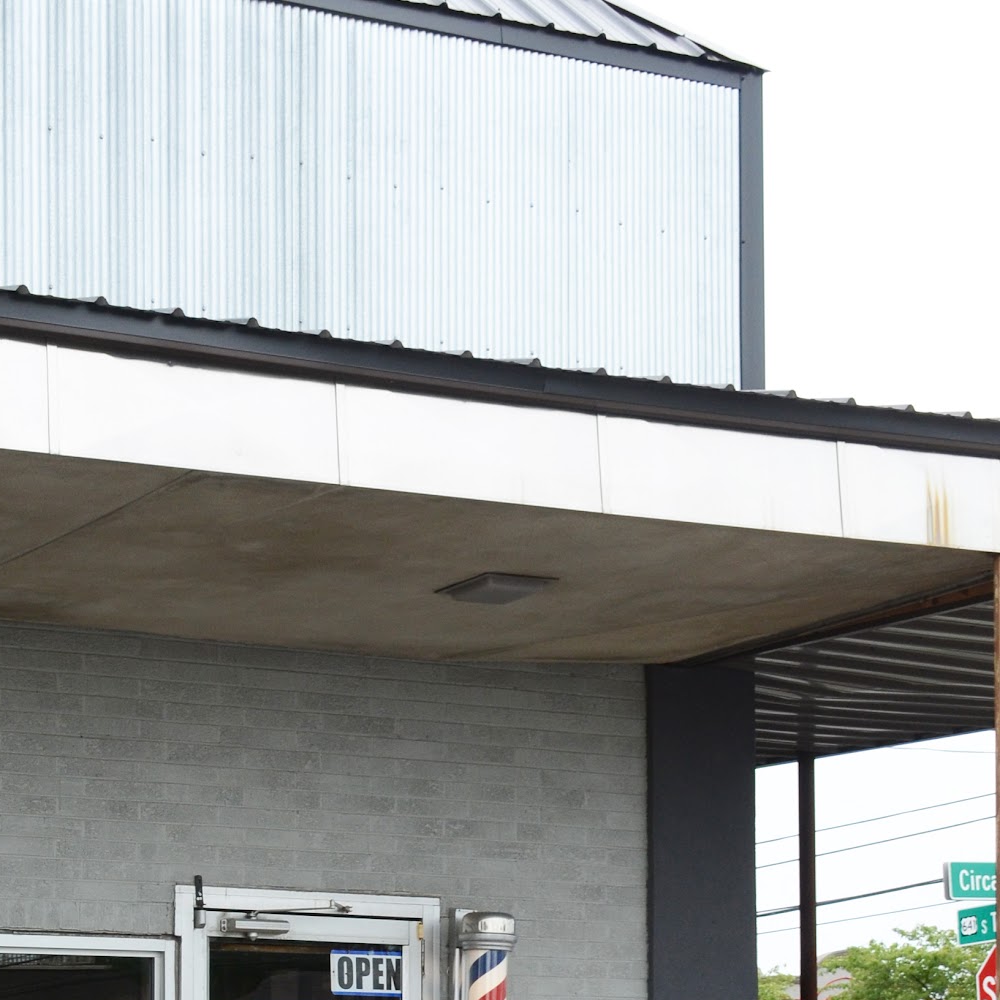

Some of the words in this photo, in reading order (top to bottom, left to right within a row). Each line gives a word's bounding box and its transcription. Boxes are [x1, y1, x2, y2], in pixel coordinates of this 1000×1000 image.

[962, 919, 976, 932] 641
[980, 919, 988, 935] S
[337, 956, 401, 991] OPEN
